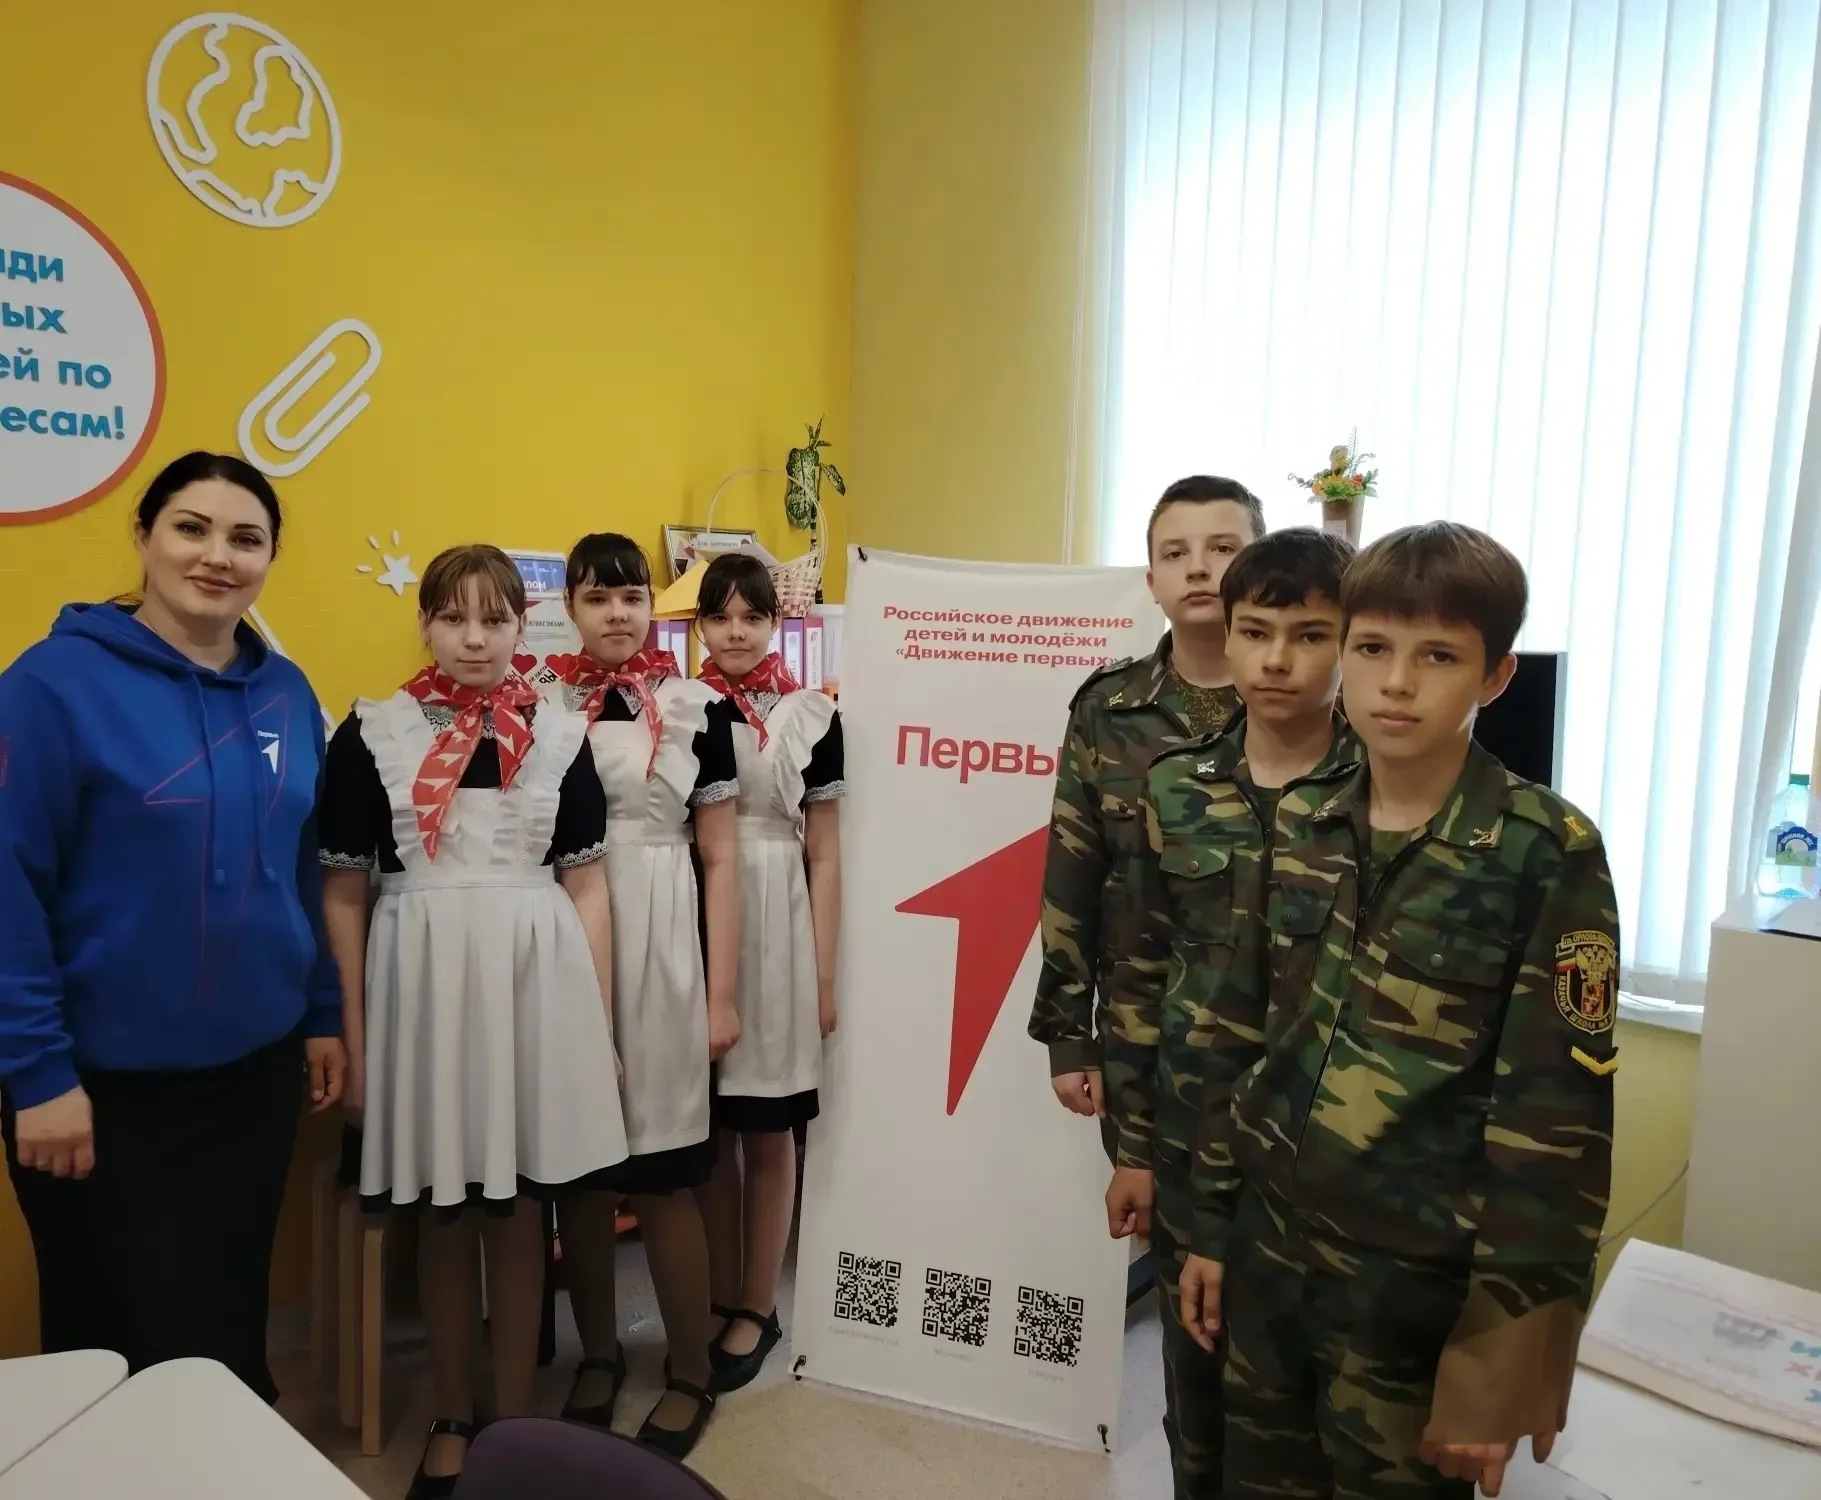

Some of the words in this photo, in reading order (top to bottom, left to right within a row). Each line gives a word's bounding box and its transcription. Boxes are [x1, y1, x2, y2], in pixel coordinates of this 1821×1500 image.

[0, 248, 63, 283] ди
[58, 360, 112, 389] по
[0, 404, 125, 440] есам!
[883, 605, 1013, 626] Российское
[1016, 613, 1134, 630] движение
[904, 627, 967, 644] детей
[971, 631, 986, 643] и
[989, 632, 1107, 648] молодёжи
[895, 644, 1018, 664] «Движение
[896, 724, 1064, 785] Первы
